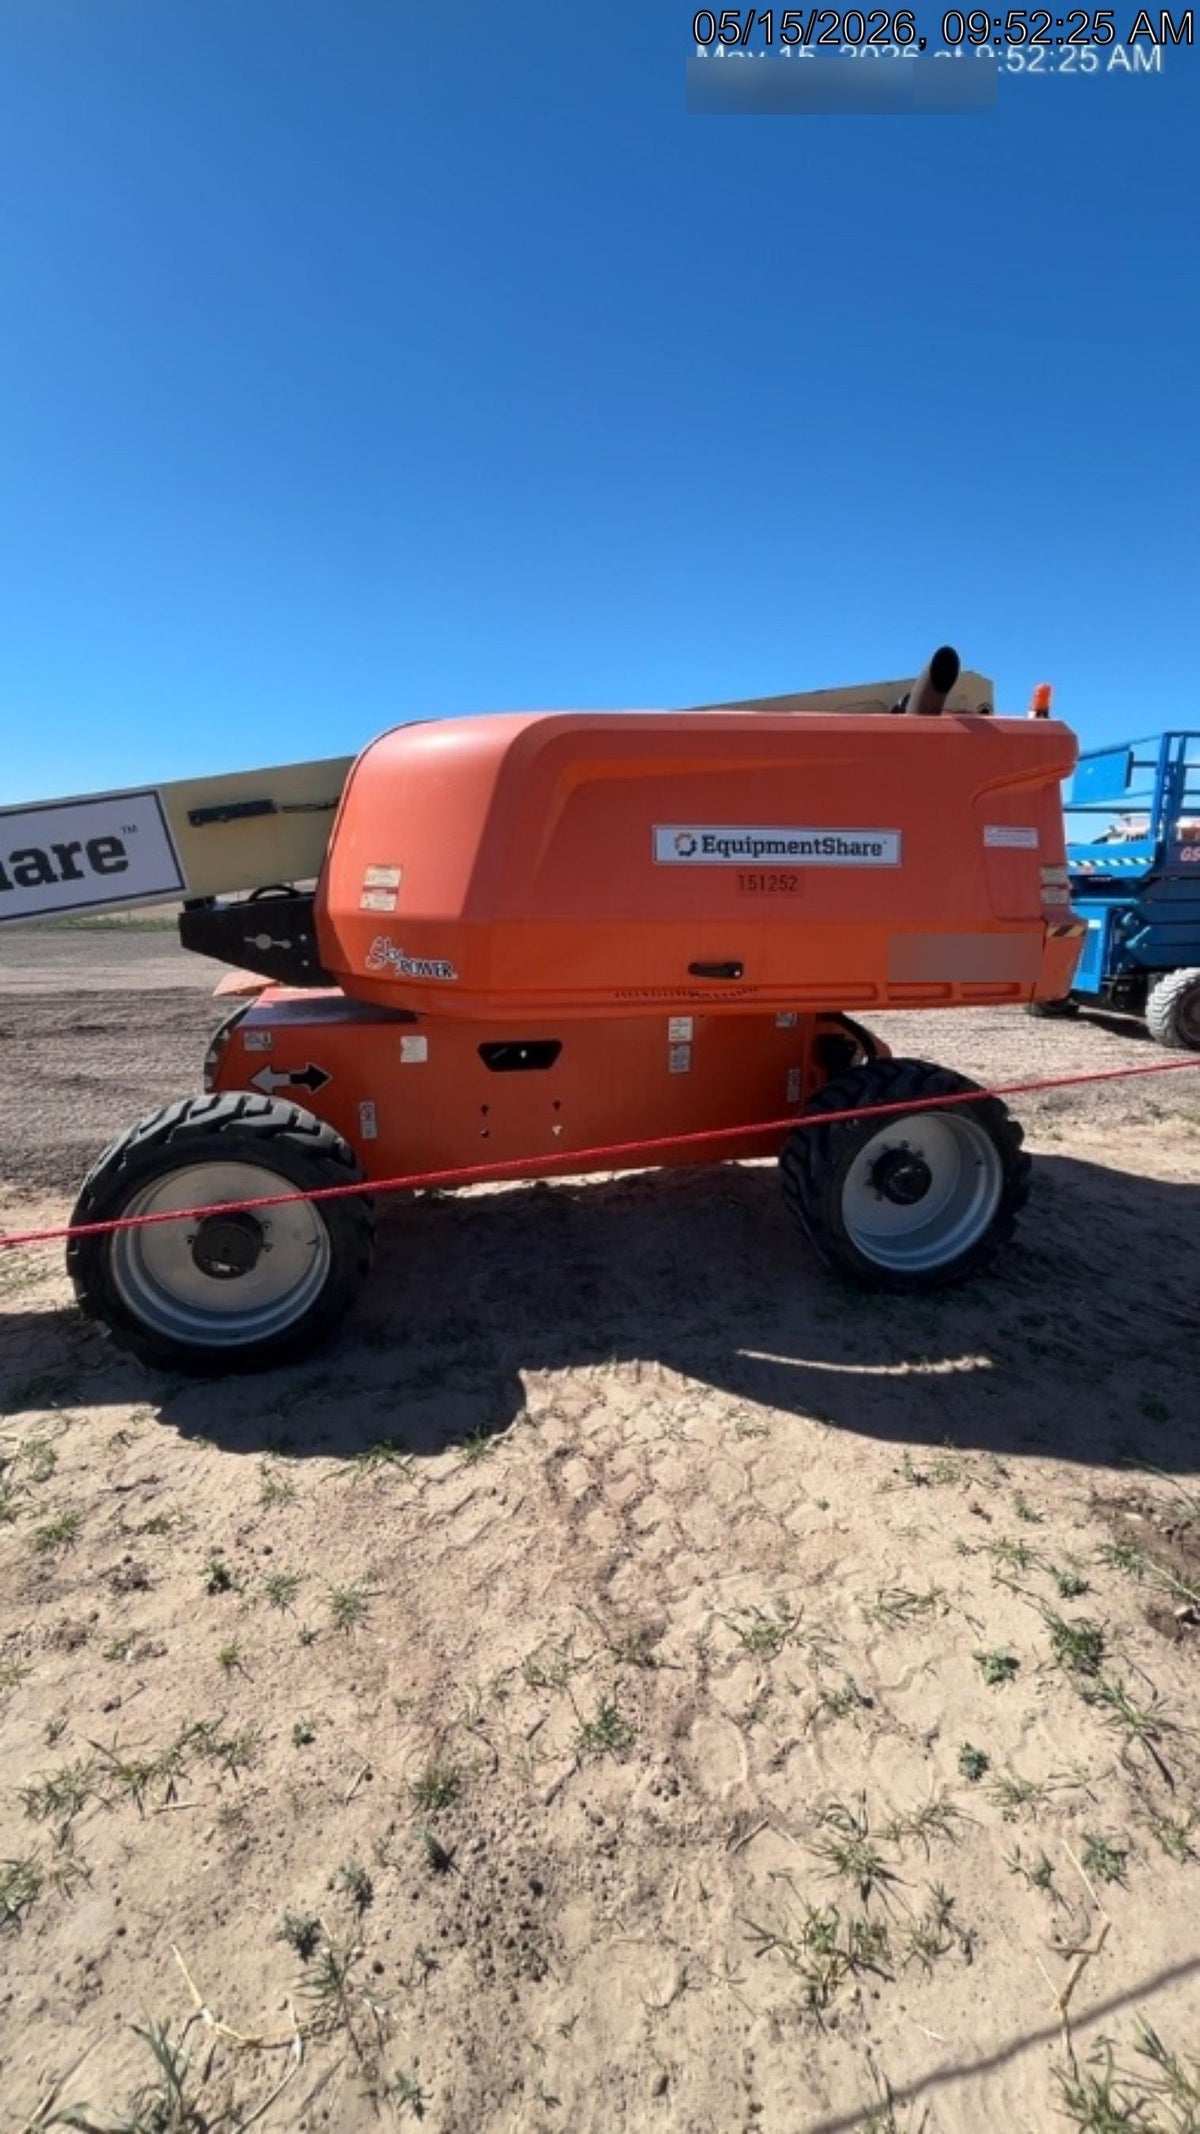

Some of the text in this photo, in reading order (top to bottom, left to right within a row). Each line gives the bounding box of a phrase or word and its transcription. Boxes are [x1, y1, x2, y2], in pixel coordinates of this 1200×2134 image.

[701, 834, 883, 858] EquipmentShare
[0, 836, 129, 891] are
[738, 874, 798, 892] 151252
